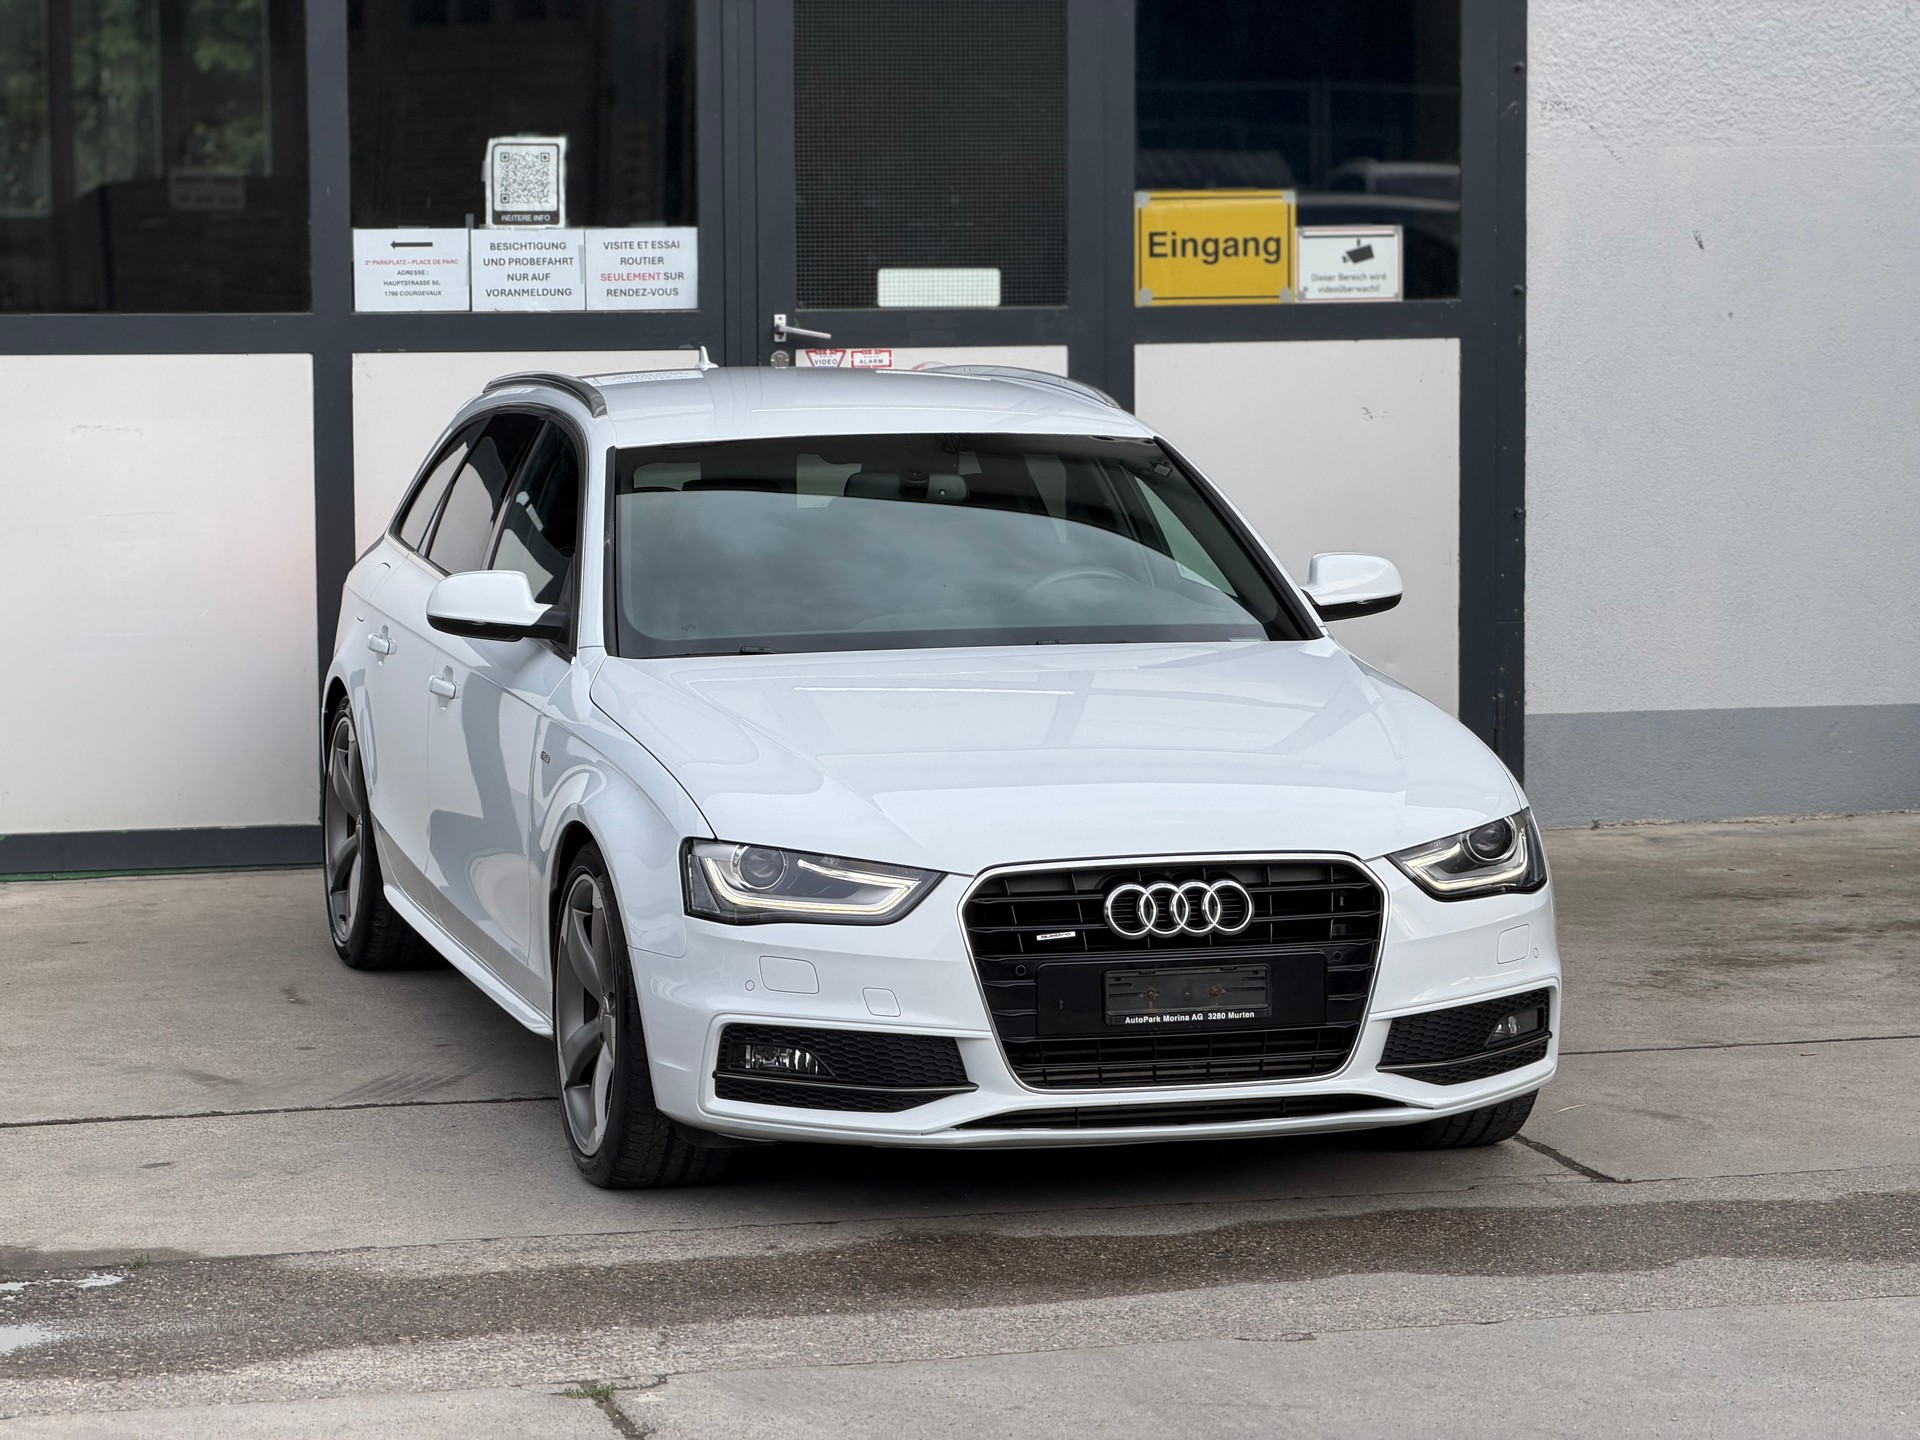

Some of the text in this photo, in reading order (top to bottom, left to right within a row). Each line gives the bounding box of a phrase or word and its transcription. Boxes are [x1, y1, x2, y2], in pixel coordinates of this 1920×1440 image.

[490, 241, 567, 251] BESICHTIGUNG
[603, 240, 680, 250] VISITE ET ESSAI
[1148, 231, 1282, 265] Eingang
[483, 257, 574, 266] UND PROBEFAHRT
[620, 256, 664, 266] ROUTIER
[507, 272, 551, 281] NUR AUF
[600, 272, 685, 281] SEULEMENT SUR
[1311, 273, 1387, 282] Dieser Bereich wird
[485, 288, 572, 297] VORANMELDUNG
[606, 287, 679, 297] RENDEZ-VOUS
[1125, 1011, 1255, 1024] AutoPark Morina AG 3280 Murten
